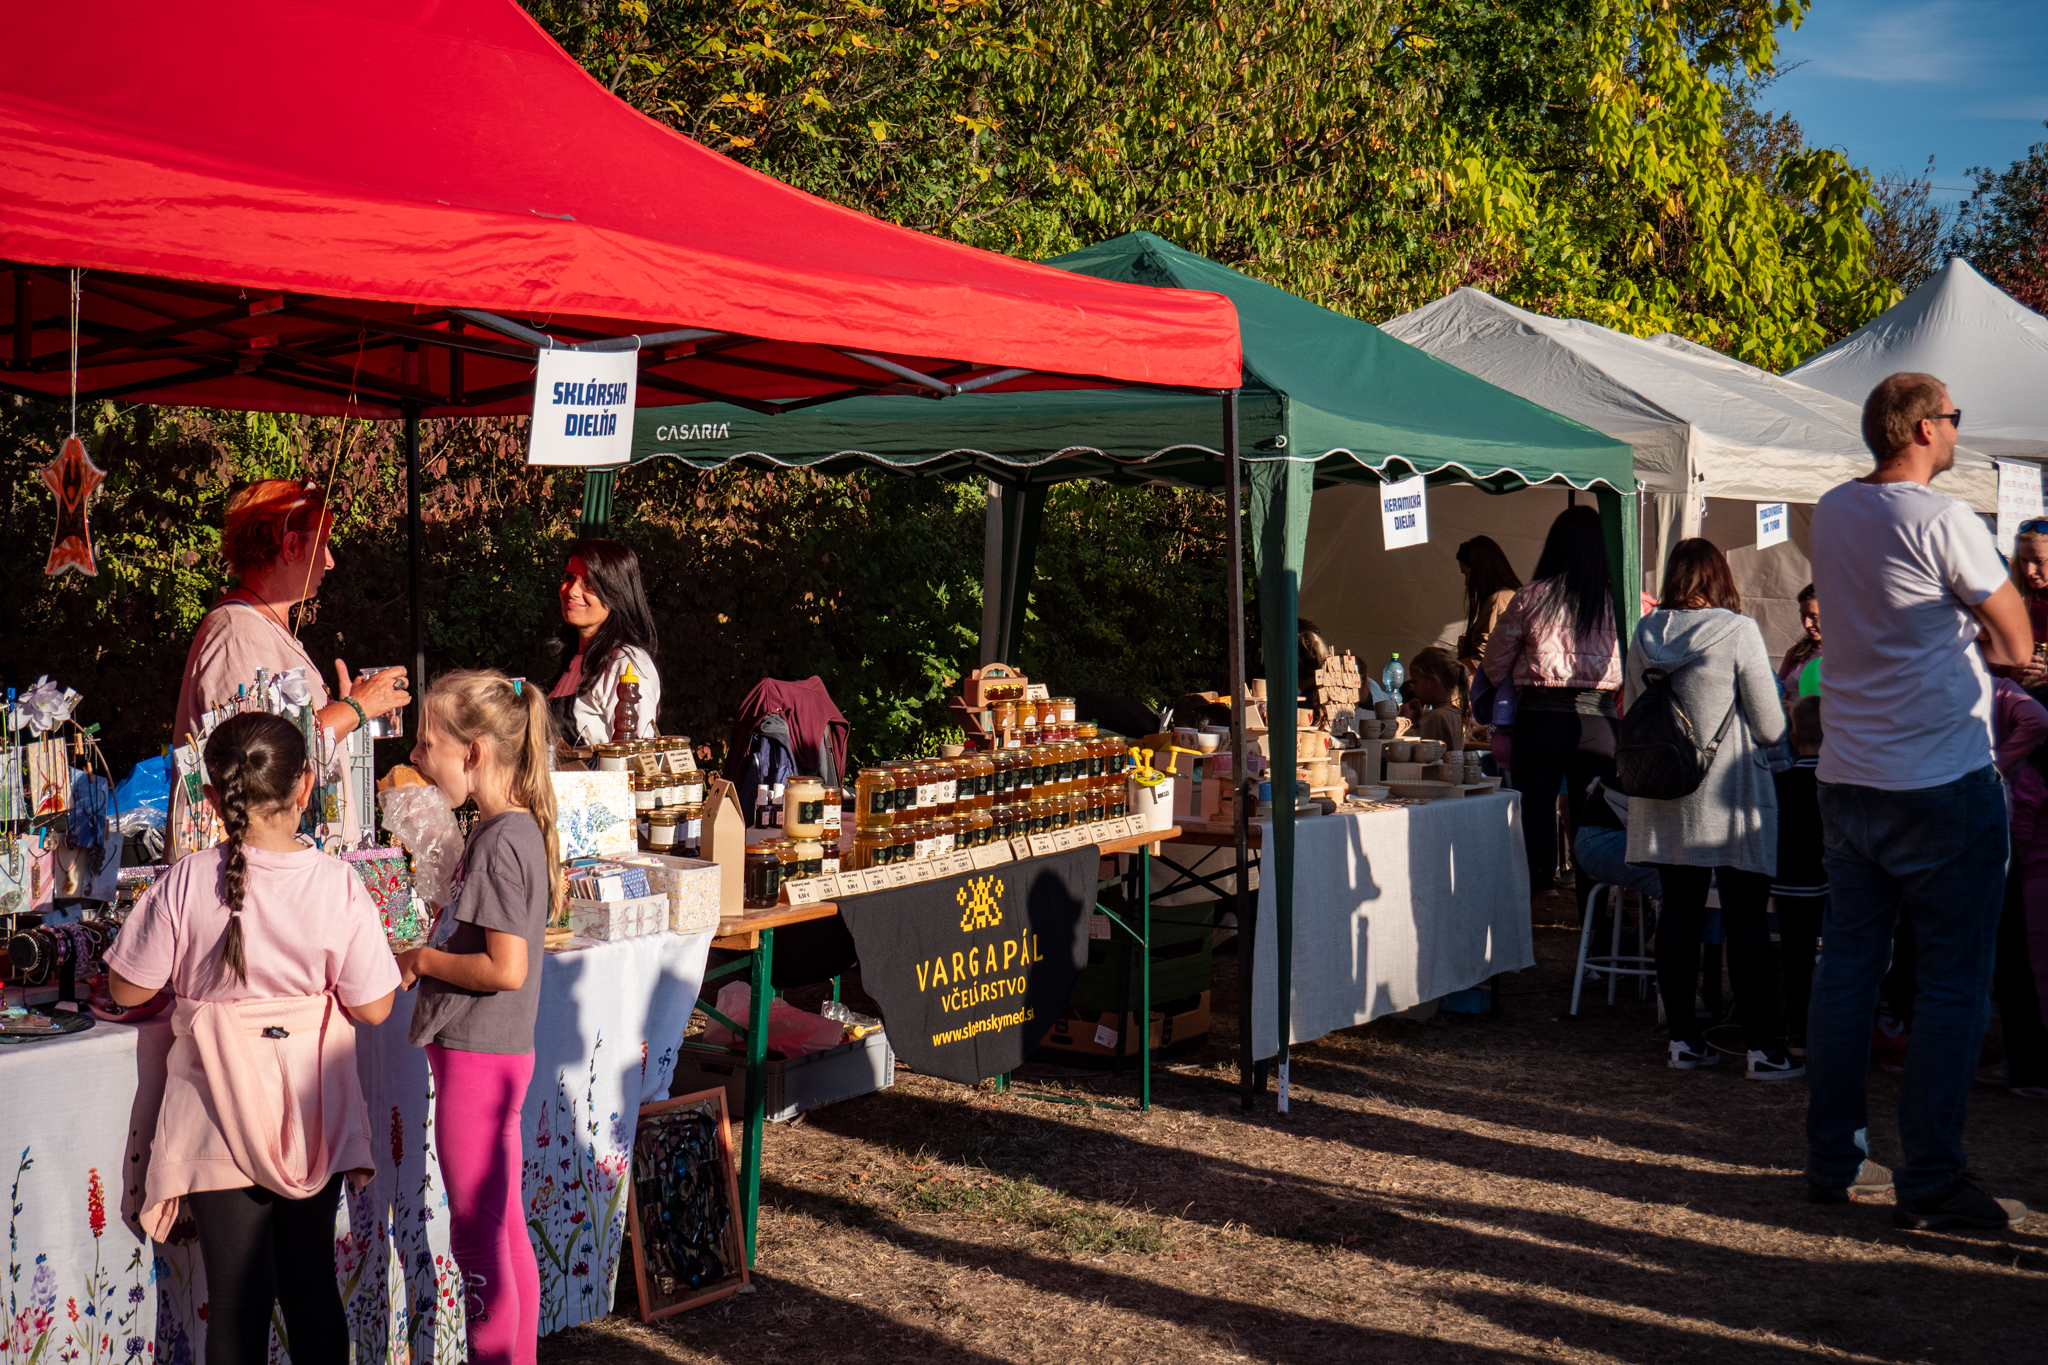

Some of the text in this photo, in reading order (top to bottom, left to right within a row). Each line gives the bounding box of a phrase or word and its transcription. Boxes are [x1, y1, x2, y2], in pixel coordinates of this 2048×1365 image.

[552, 378, 628, 406] SKLÁRSKA
[564, 409, 617, 437] DIELŇA
[656, 423, 729, 442] CASARIA
[1384, 491, 1421, 513] KERAMICKÁ
[1394, 511, 1415, 530] DIELŇA
[916, 928, 1043, 992] VARGAPÁL
